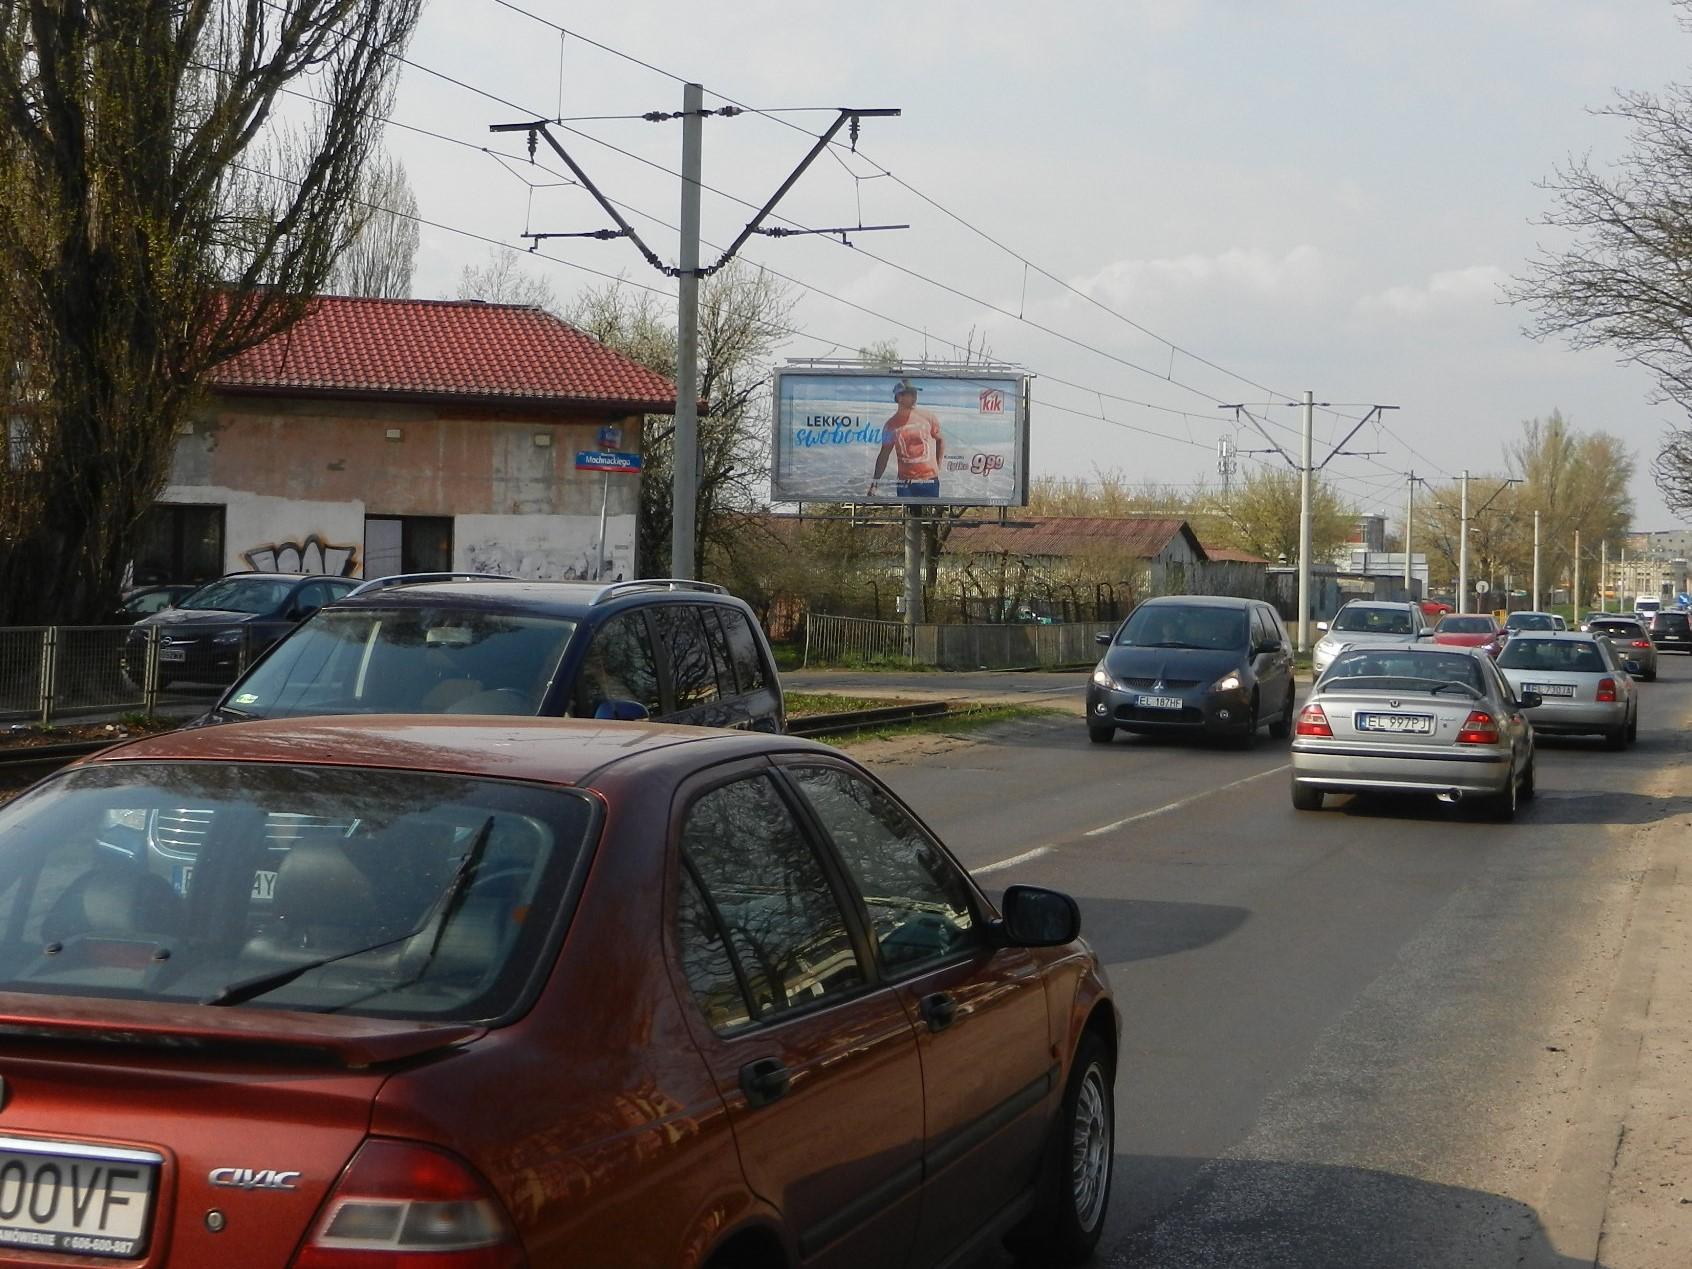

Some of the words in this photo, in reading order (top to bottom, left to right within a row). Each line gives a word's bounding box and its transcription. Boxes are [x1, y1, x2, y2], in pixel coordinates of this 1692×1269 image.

[806, 415, 852, 428] LEKKO
[586, 455, 630, 467] Mochnackiego
[1139, 696, 1151, 705] EL
[1368, 715, 1384, 728] EL
[1390, 716, 1426, 729] 997PJ
[207, 1167, 301, 1188] CIVIC
